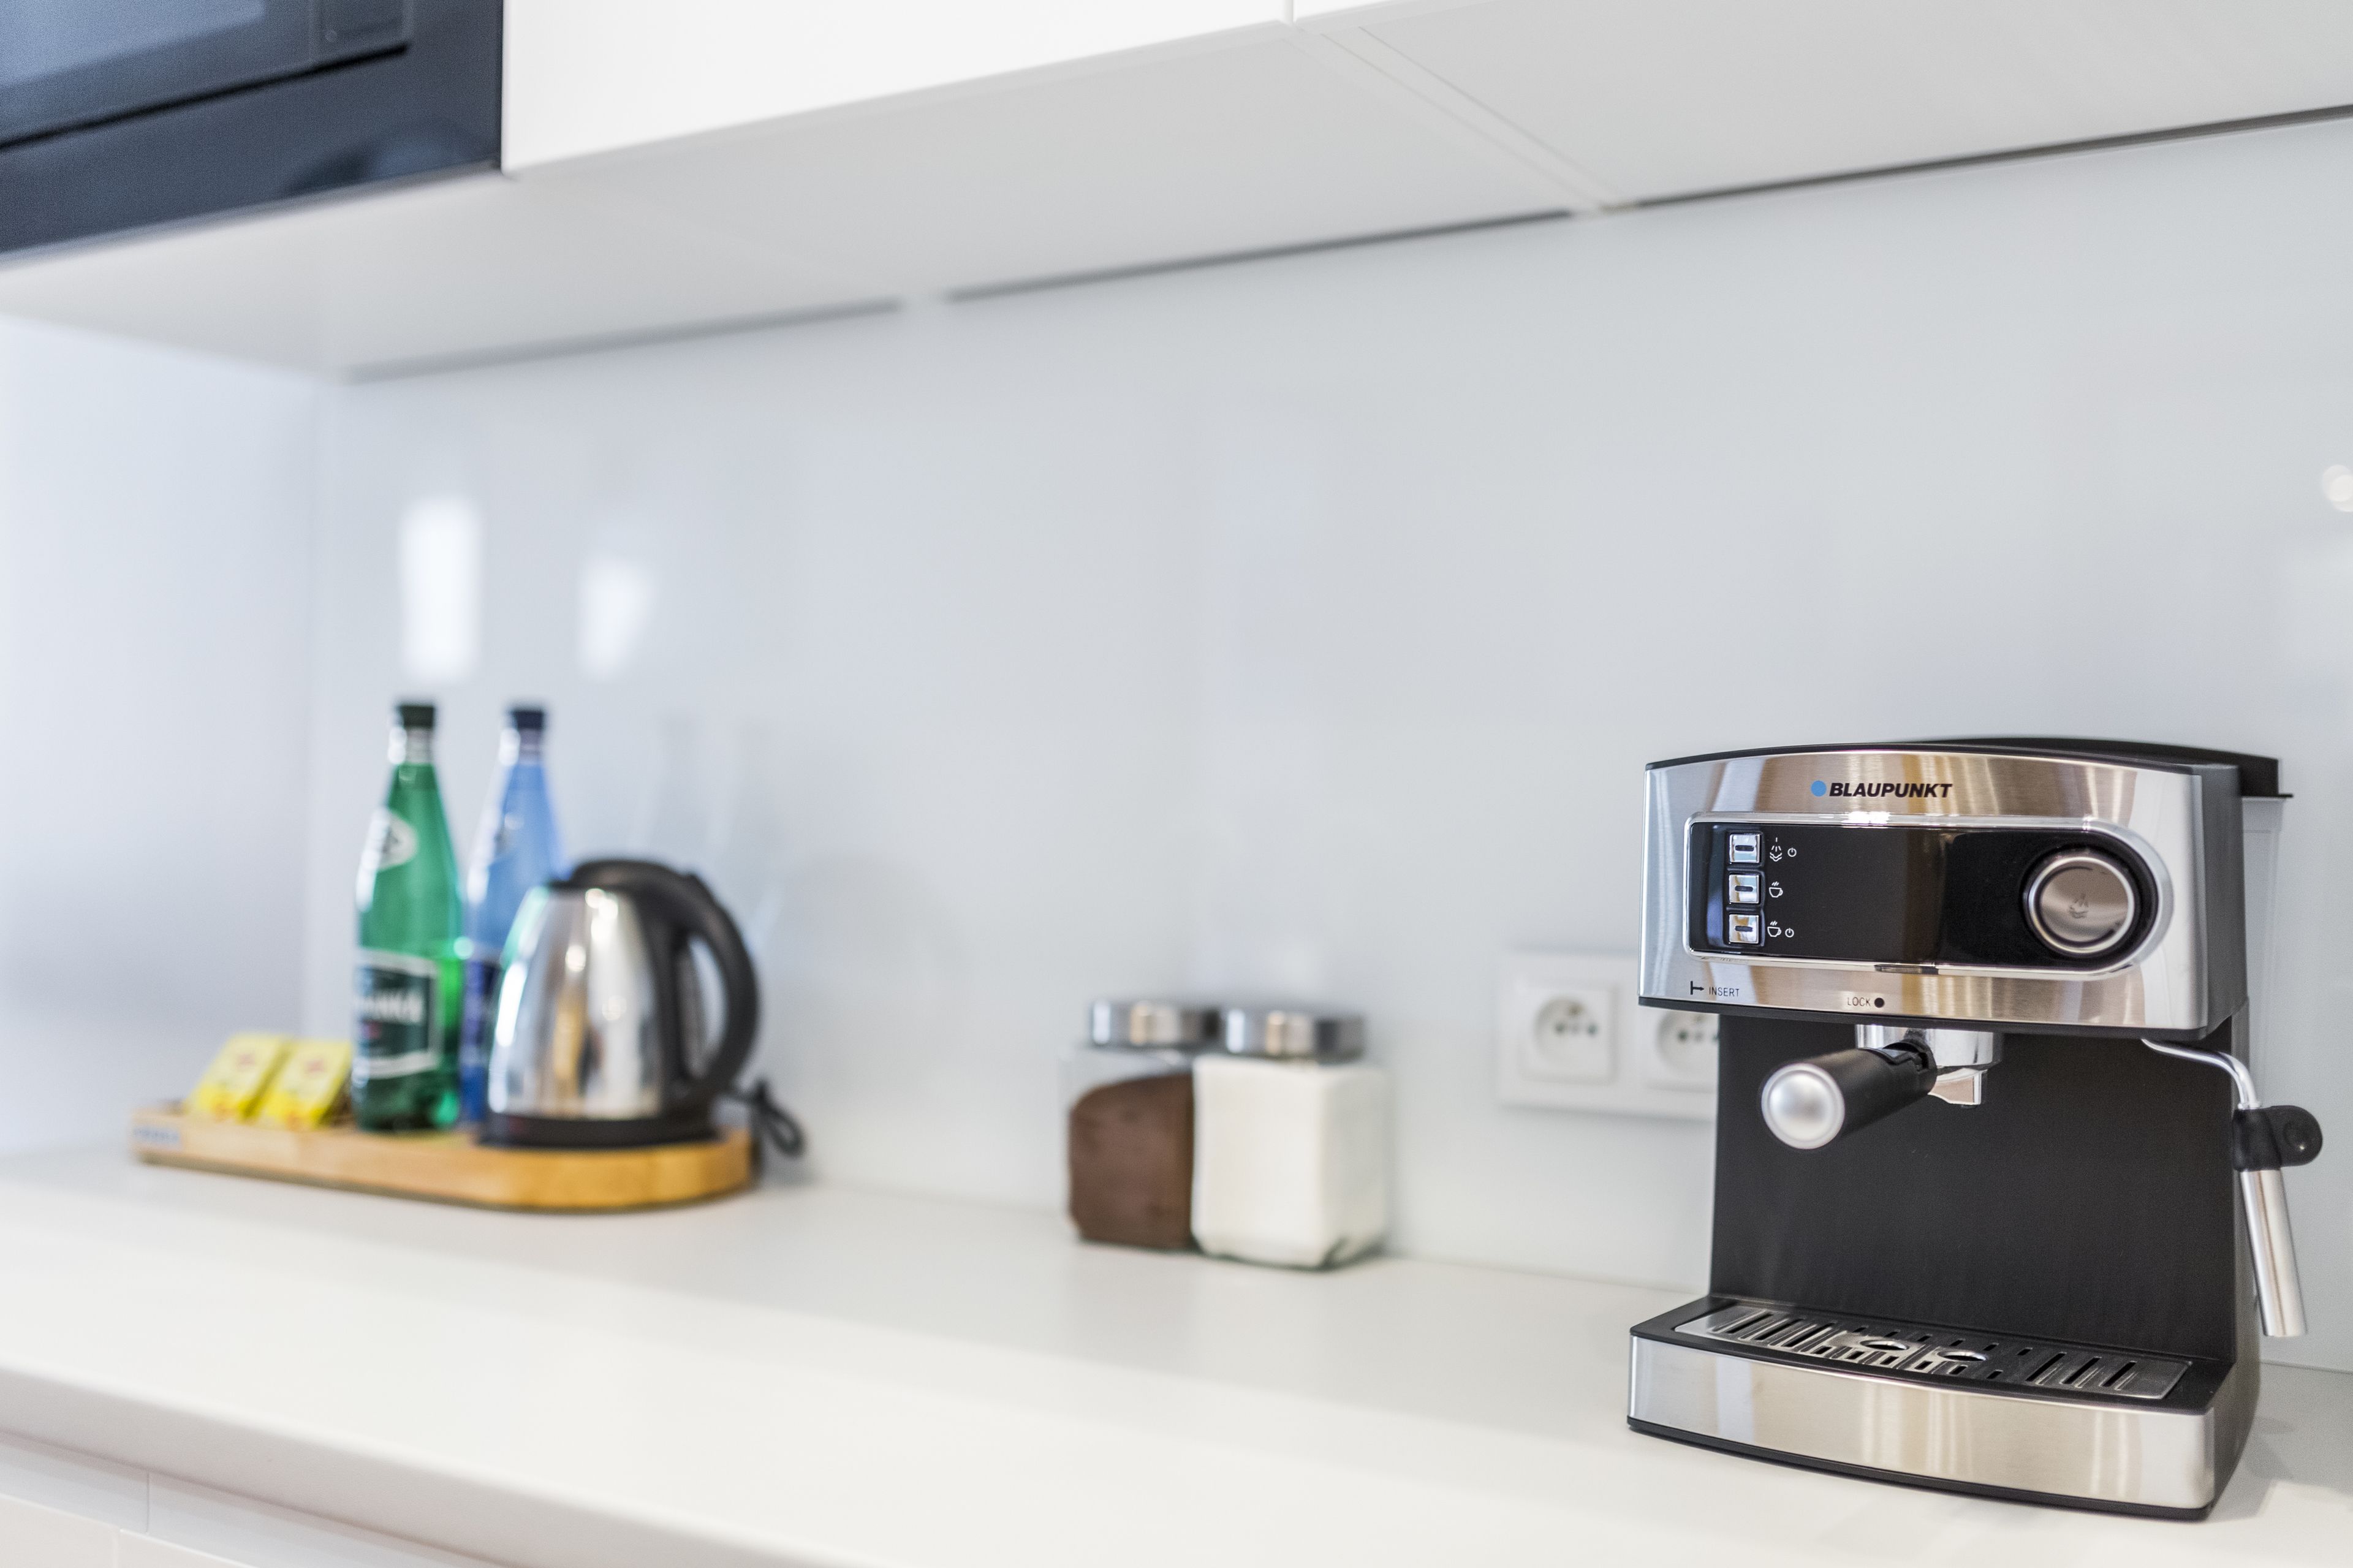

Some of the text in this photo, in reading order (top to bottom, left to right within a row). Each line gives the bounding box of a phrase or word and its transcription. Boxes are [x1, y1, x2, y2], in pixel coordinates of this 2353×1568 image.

[1829, 782, 1953, 798] BLAUPUNKT
[1708, 987, 1740, 997] INSERT
[1847, 996, 1871, 1007] LOCK
